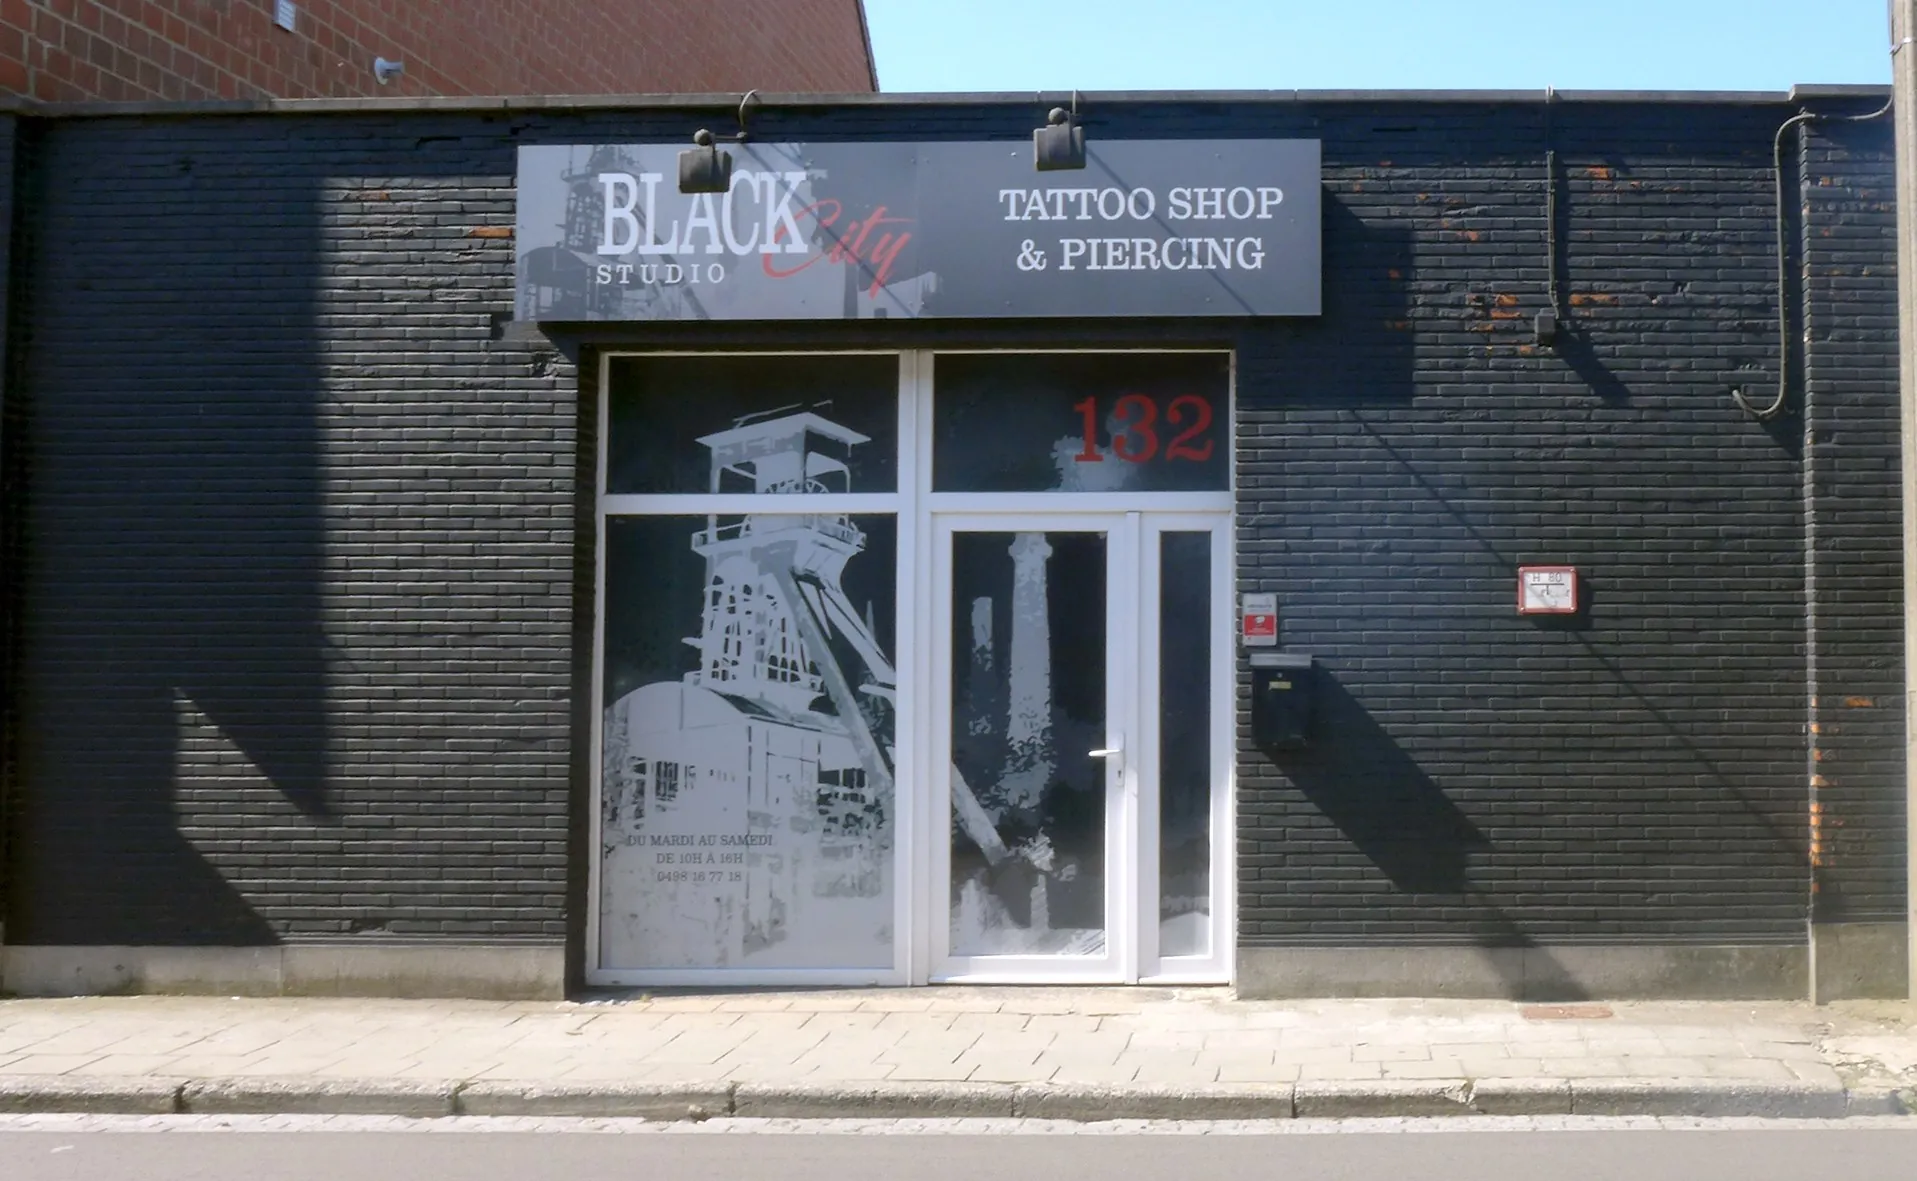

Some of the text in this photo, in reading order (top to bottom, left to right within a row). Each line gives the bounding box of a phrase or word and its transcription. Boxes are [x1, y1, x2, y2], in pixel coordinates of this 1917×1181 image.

[597, 168, 809, 256] BLACK
[999, 187, 1284, 221] TATTOO SHOP
[761, 199, 918, 300] City
[1016, 237, 1266, 271] & PIERCING
[596, 263, 726, 285] STUDIO
[1073, 393, 1215, 464] 132
[627, 834, 773, 846] DU MARDI AU SAMEDI
[656, 852, 675, 864] DE
[679, 852, 703, 864] 10H
[720, 852, 744, 864] 16H
[656, 871, 688, 882] 0498
[709, 871, 724, 882] 77
[728, 871, 742, 882] 18
